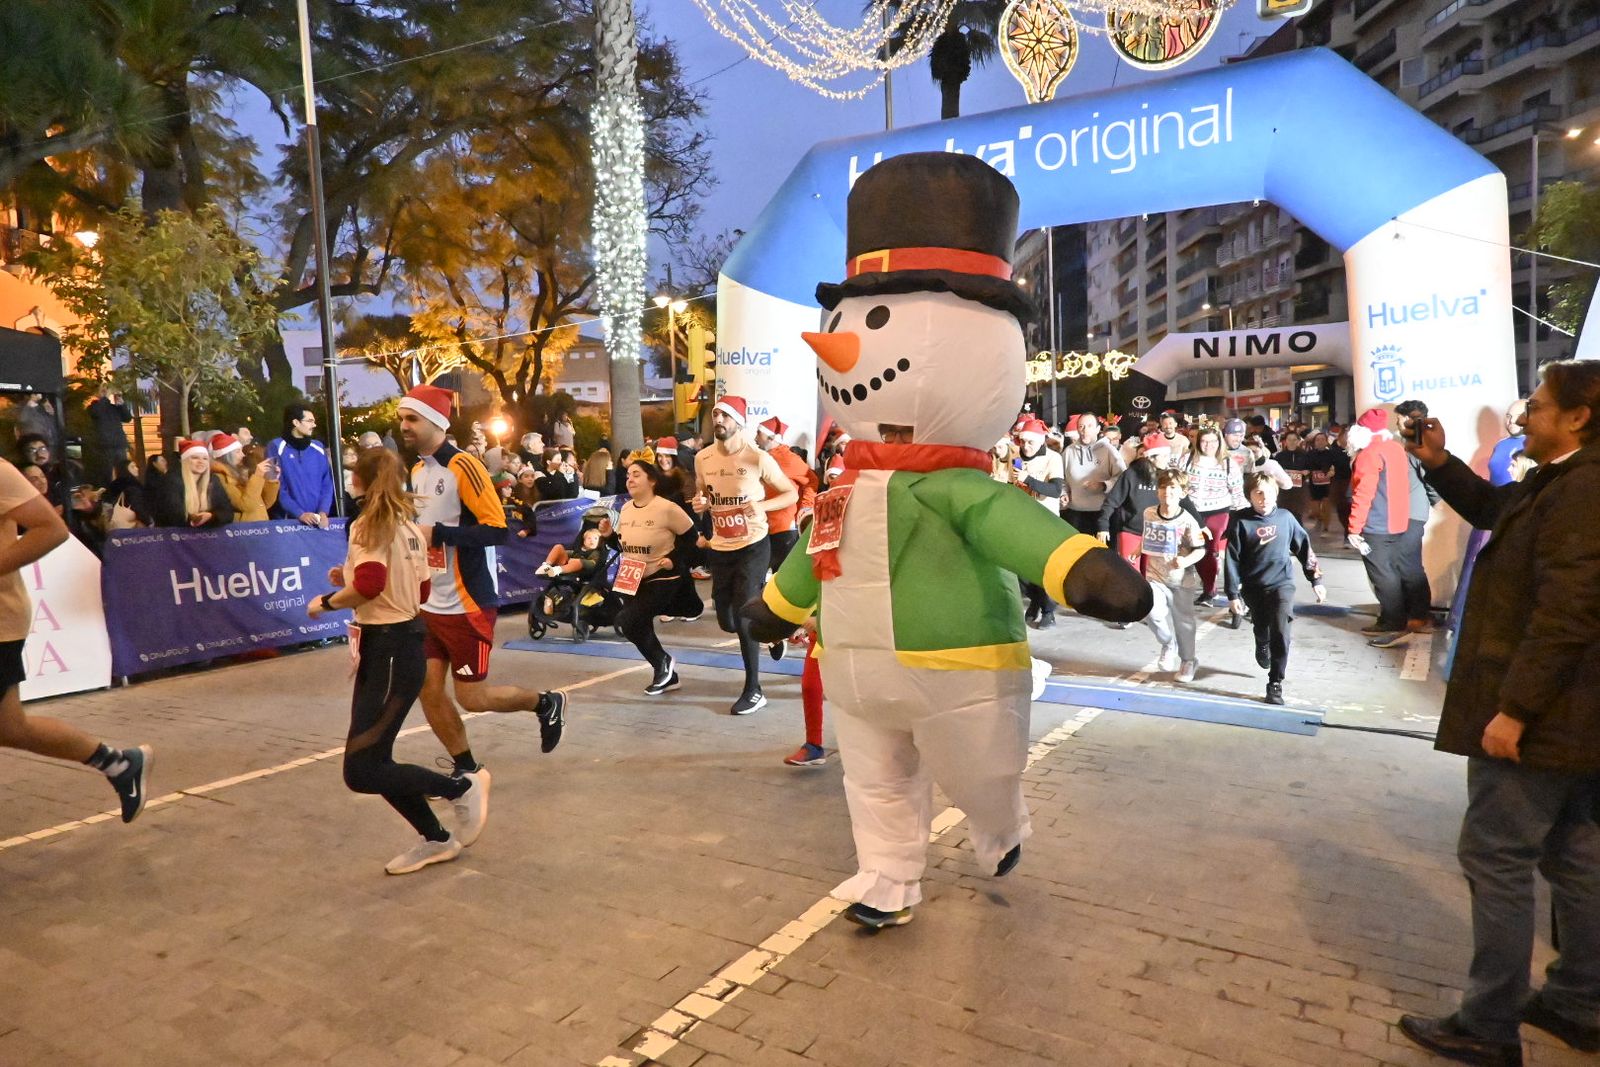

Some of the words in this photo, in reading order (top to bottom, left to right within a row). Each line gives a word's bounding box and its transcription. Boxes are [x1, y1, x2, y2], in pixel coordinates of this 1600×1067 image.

[1035, 87, 1232, 174] original
[1367, 294, 1479, 328] Huelva
[1193, 331, 1317, 358] NIMO
[717, 346, 772, 365] Huelva
[1412, 373, 1483, 392] HUELVA
[747, 406, 769, 416] LVA
[234, 528, 270, 536] ONUPOLIS
[1257, 525, 1277, 538] CR7
[170, 561, 303, 606] Huelva
[263, 594, 306, 612] original
[306, 621, 340, 633] ONUPOLIS
